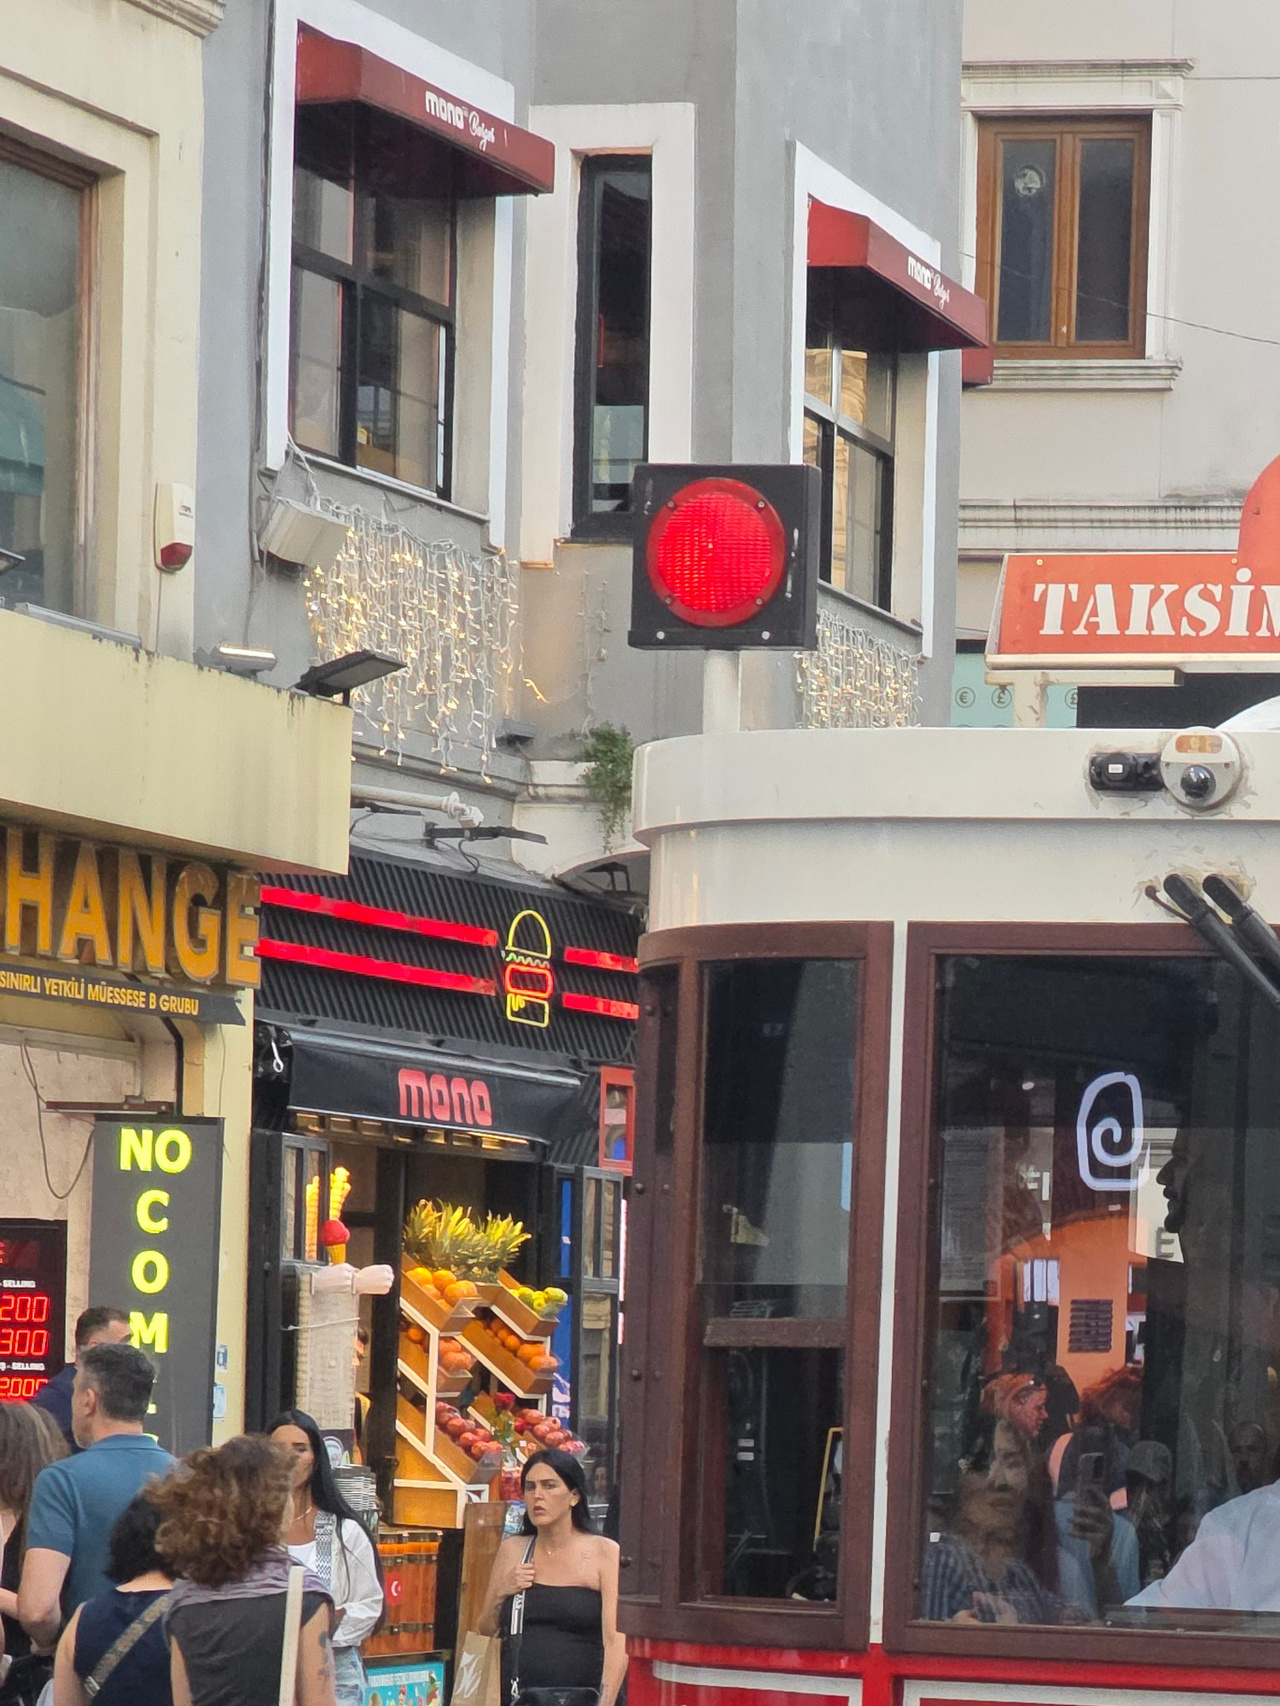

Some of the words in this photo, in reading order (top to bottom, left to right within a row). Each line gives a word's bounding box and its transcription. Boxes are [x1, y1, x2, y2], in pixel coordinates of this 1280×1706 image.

[0, 970, 41, 993] SINIRLI
[44, 977, 85, 1000] YETKİLİ
[87, 981, 147, 1009] MÜESSESE
[149, 992, 157, 1010] B
[159, 995, 200, 1016] GRUBU
[397, 1067, 493, 1127] mono
[119, 1127, 193, 1174] NO
